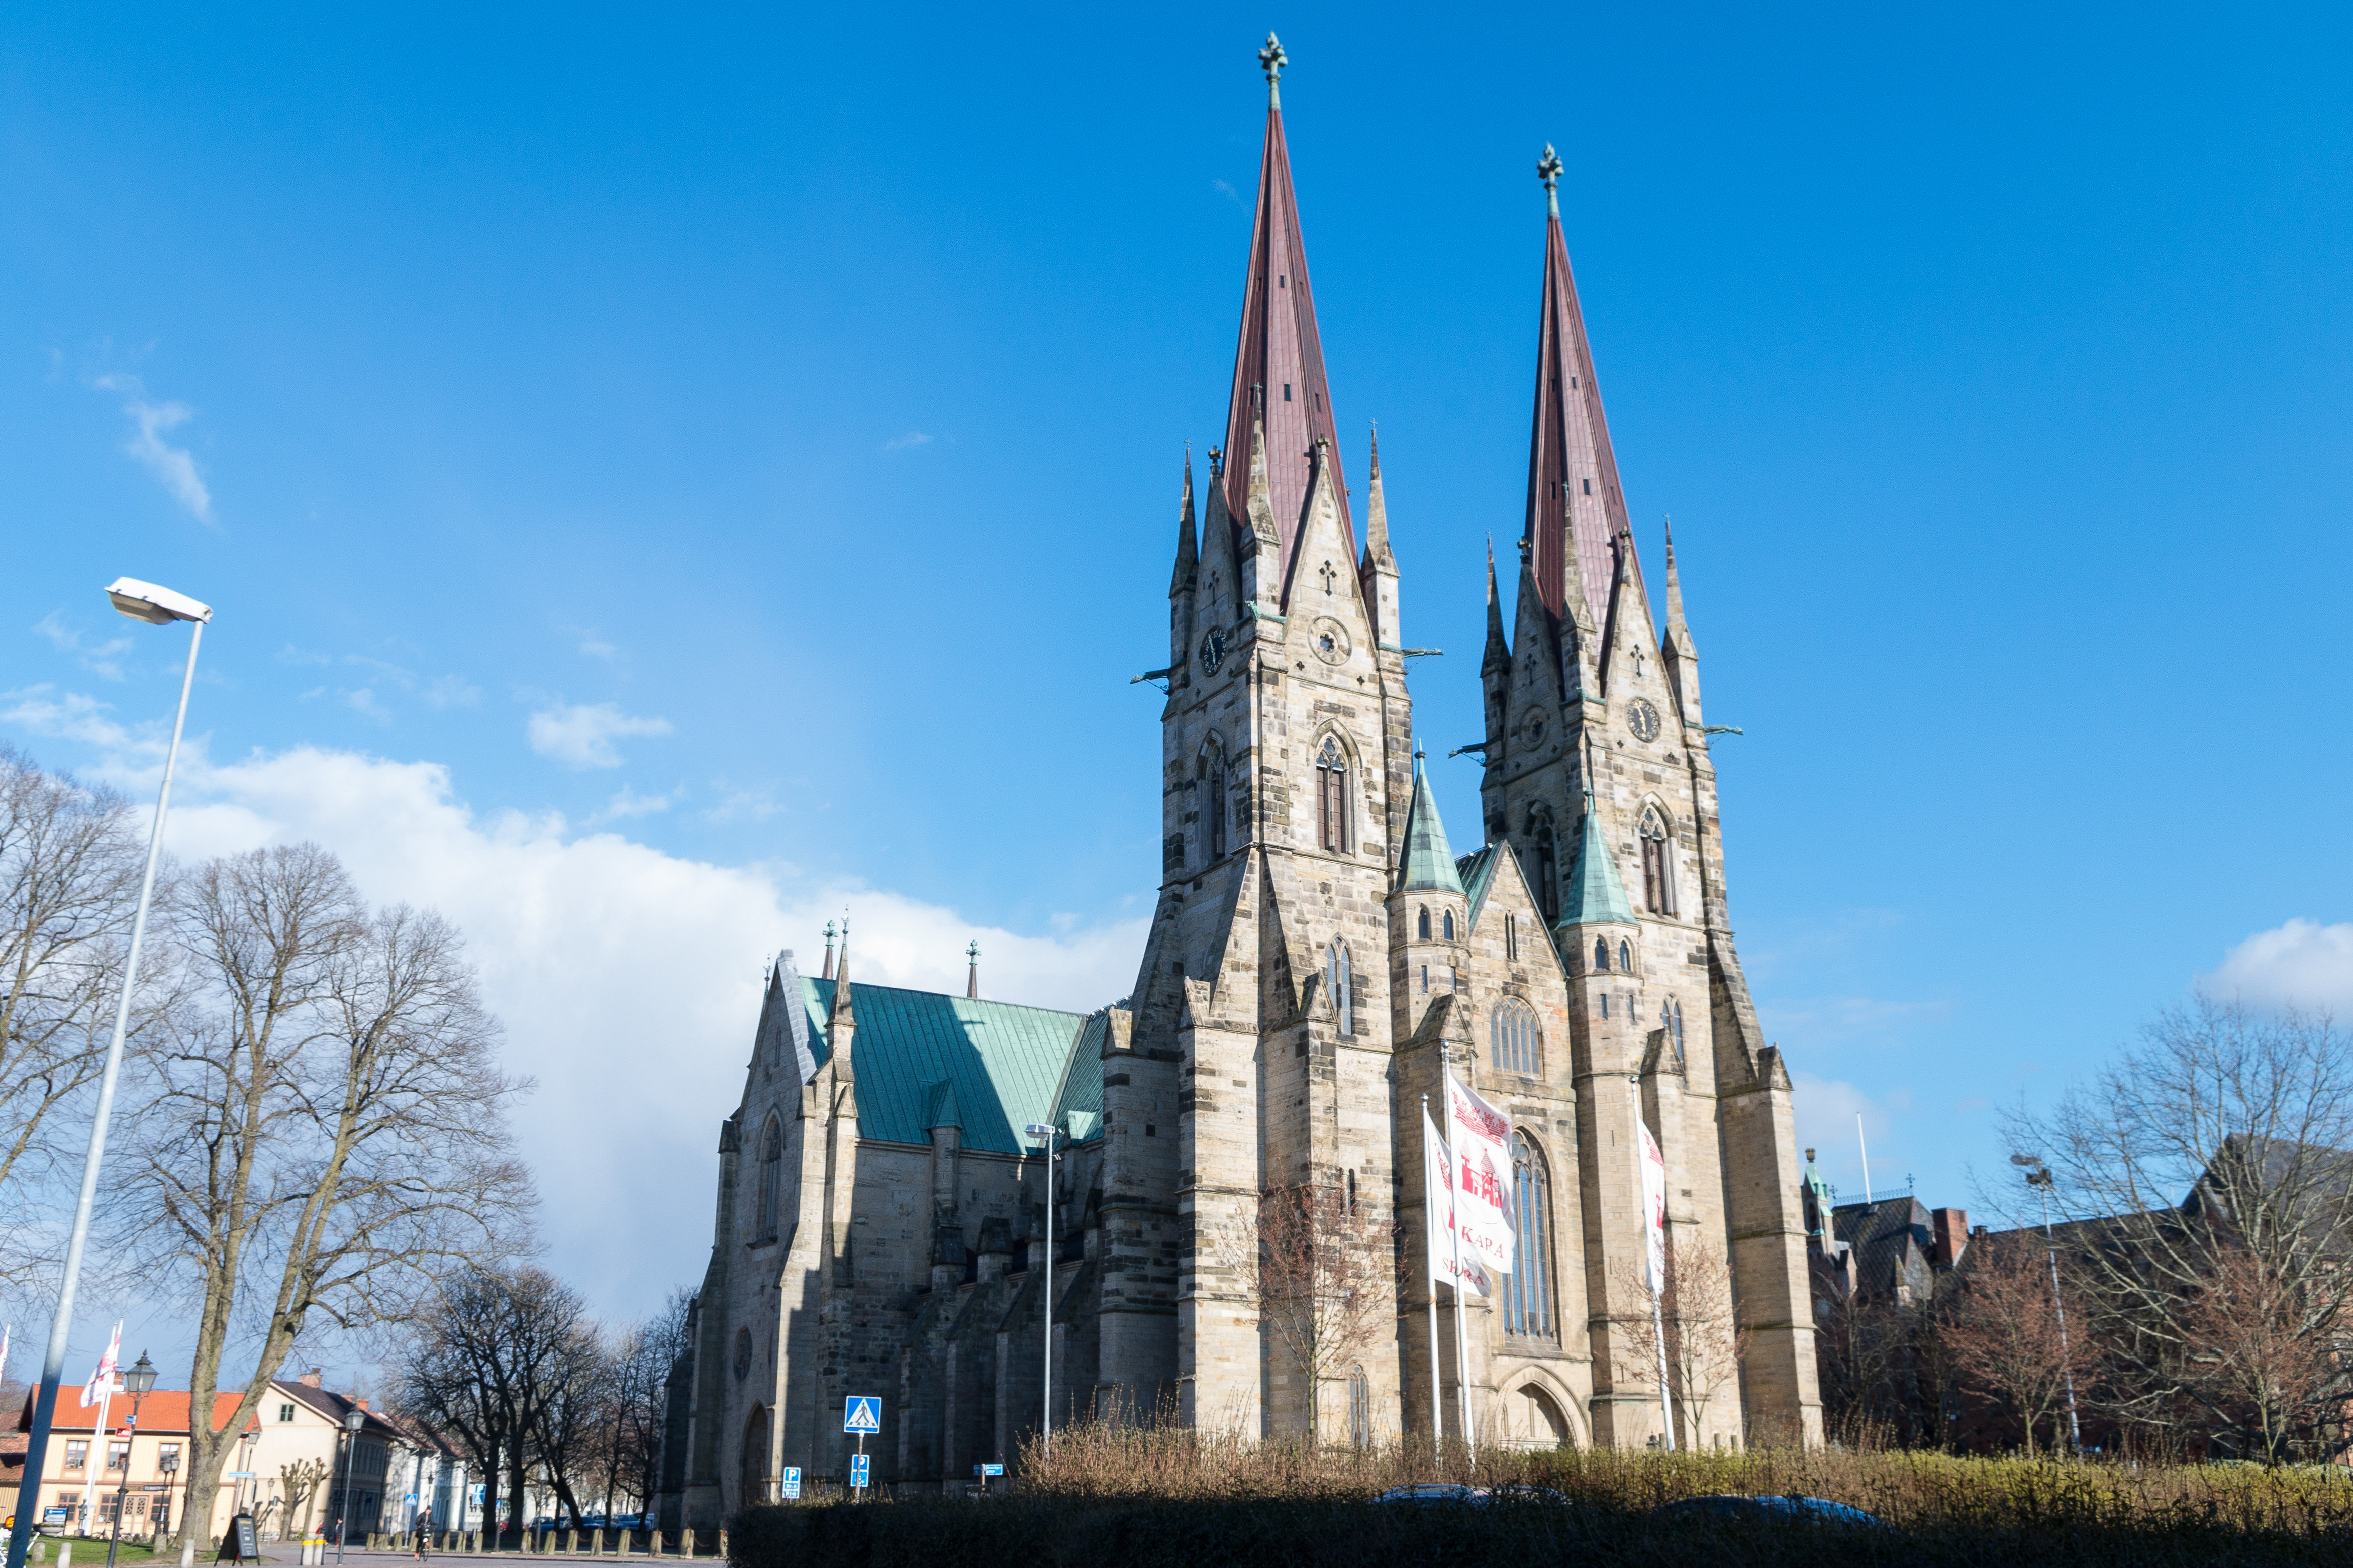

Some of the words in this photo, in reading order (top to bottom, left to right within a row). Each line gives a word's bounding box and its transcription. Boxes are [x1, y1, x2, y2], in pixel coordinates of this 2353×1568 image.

[1461, 1225, 1504, 1258] KARA
[789, 1469, 797, 1481] P
[477, 1485, 483, 1493] P
